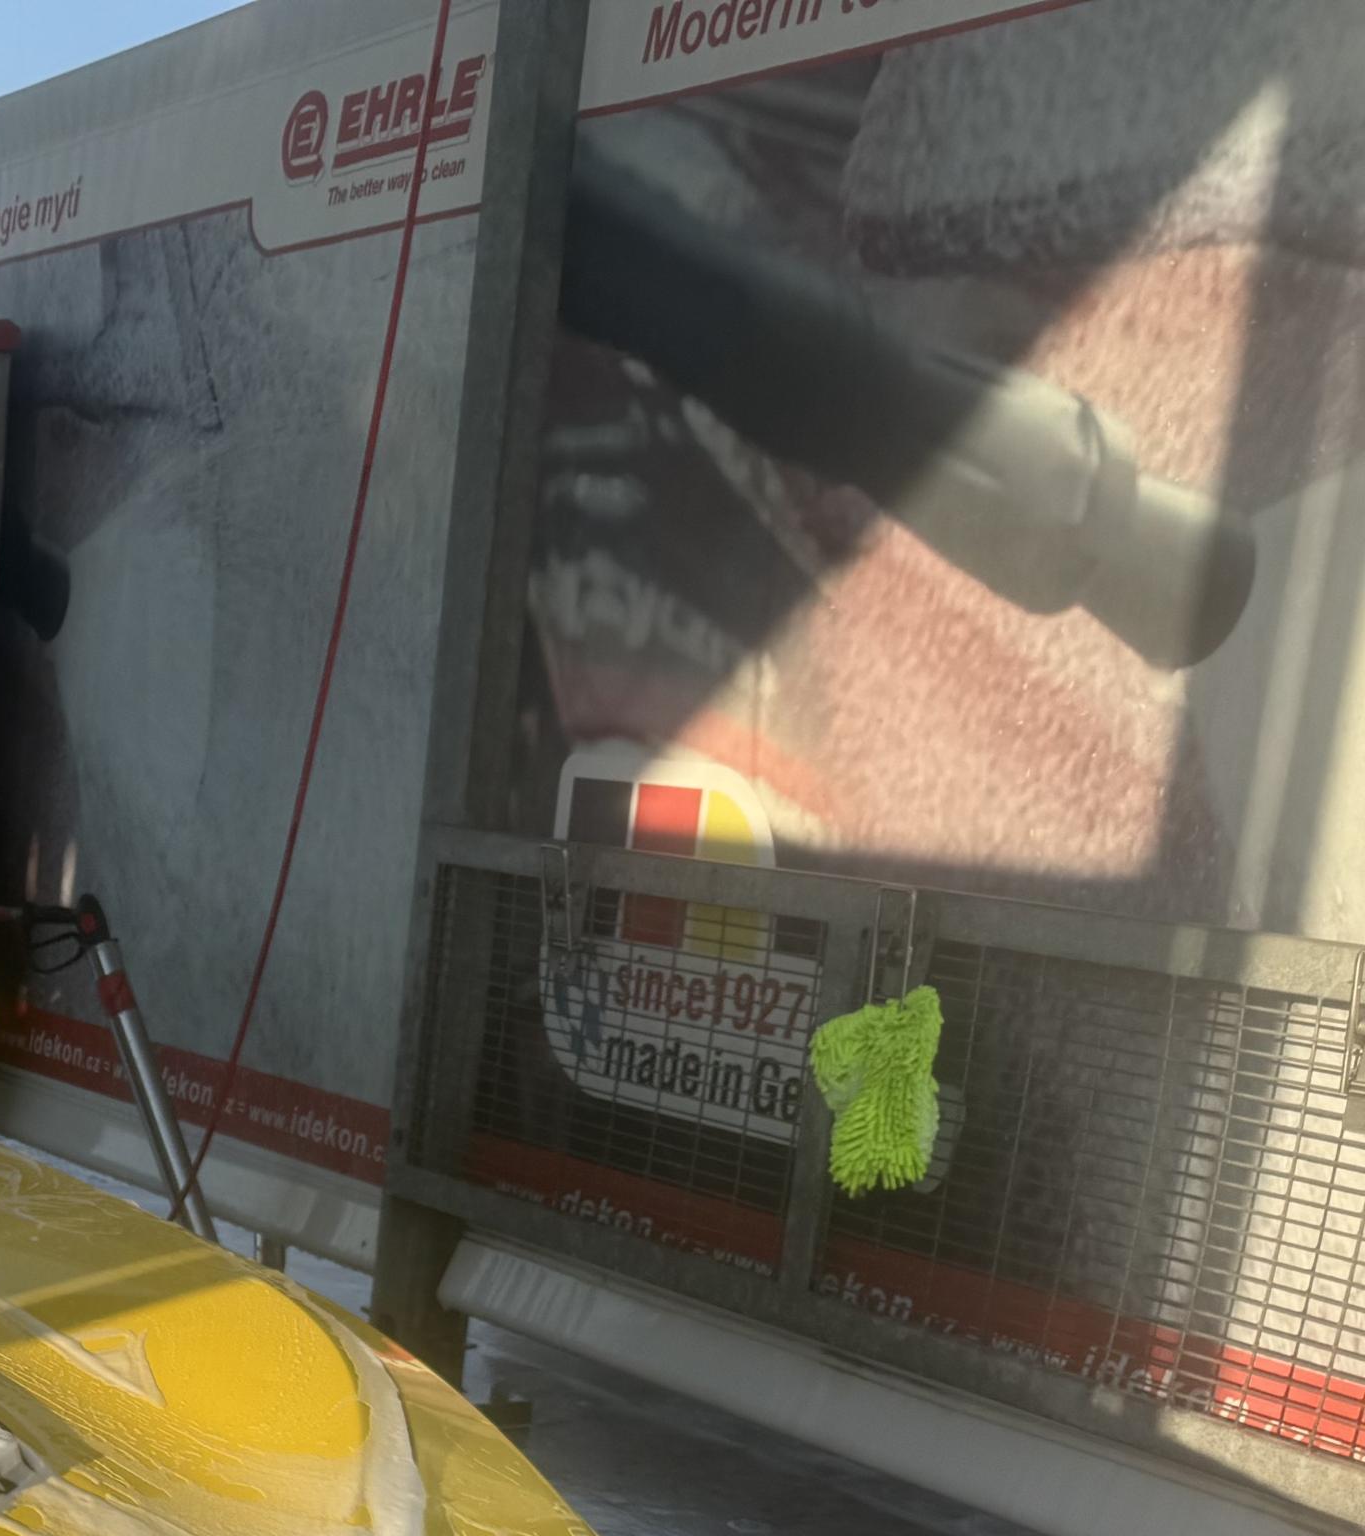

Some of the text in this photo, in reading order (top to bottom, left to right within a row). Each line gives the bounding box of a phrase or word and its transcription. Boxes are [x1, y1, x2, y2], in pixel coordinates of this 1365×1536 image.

[34, 173, 84, 233] mytí
[328, 186, 346, 207] The
[350, 176, 383, 203] better
[387, 172, 413, 194] way
[432, 157, 465, 181] clean
[0, 1028, 101, 1073] www.idekon.cz
[248, 1105, 388, 1163] www.idekon.c
[604, 1036, 701, 1098] made
[708, 1047, 746, 1109] in
